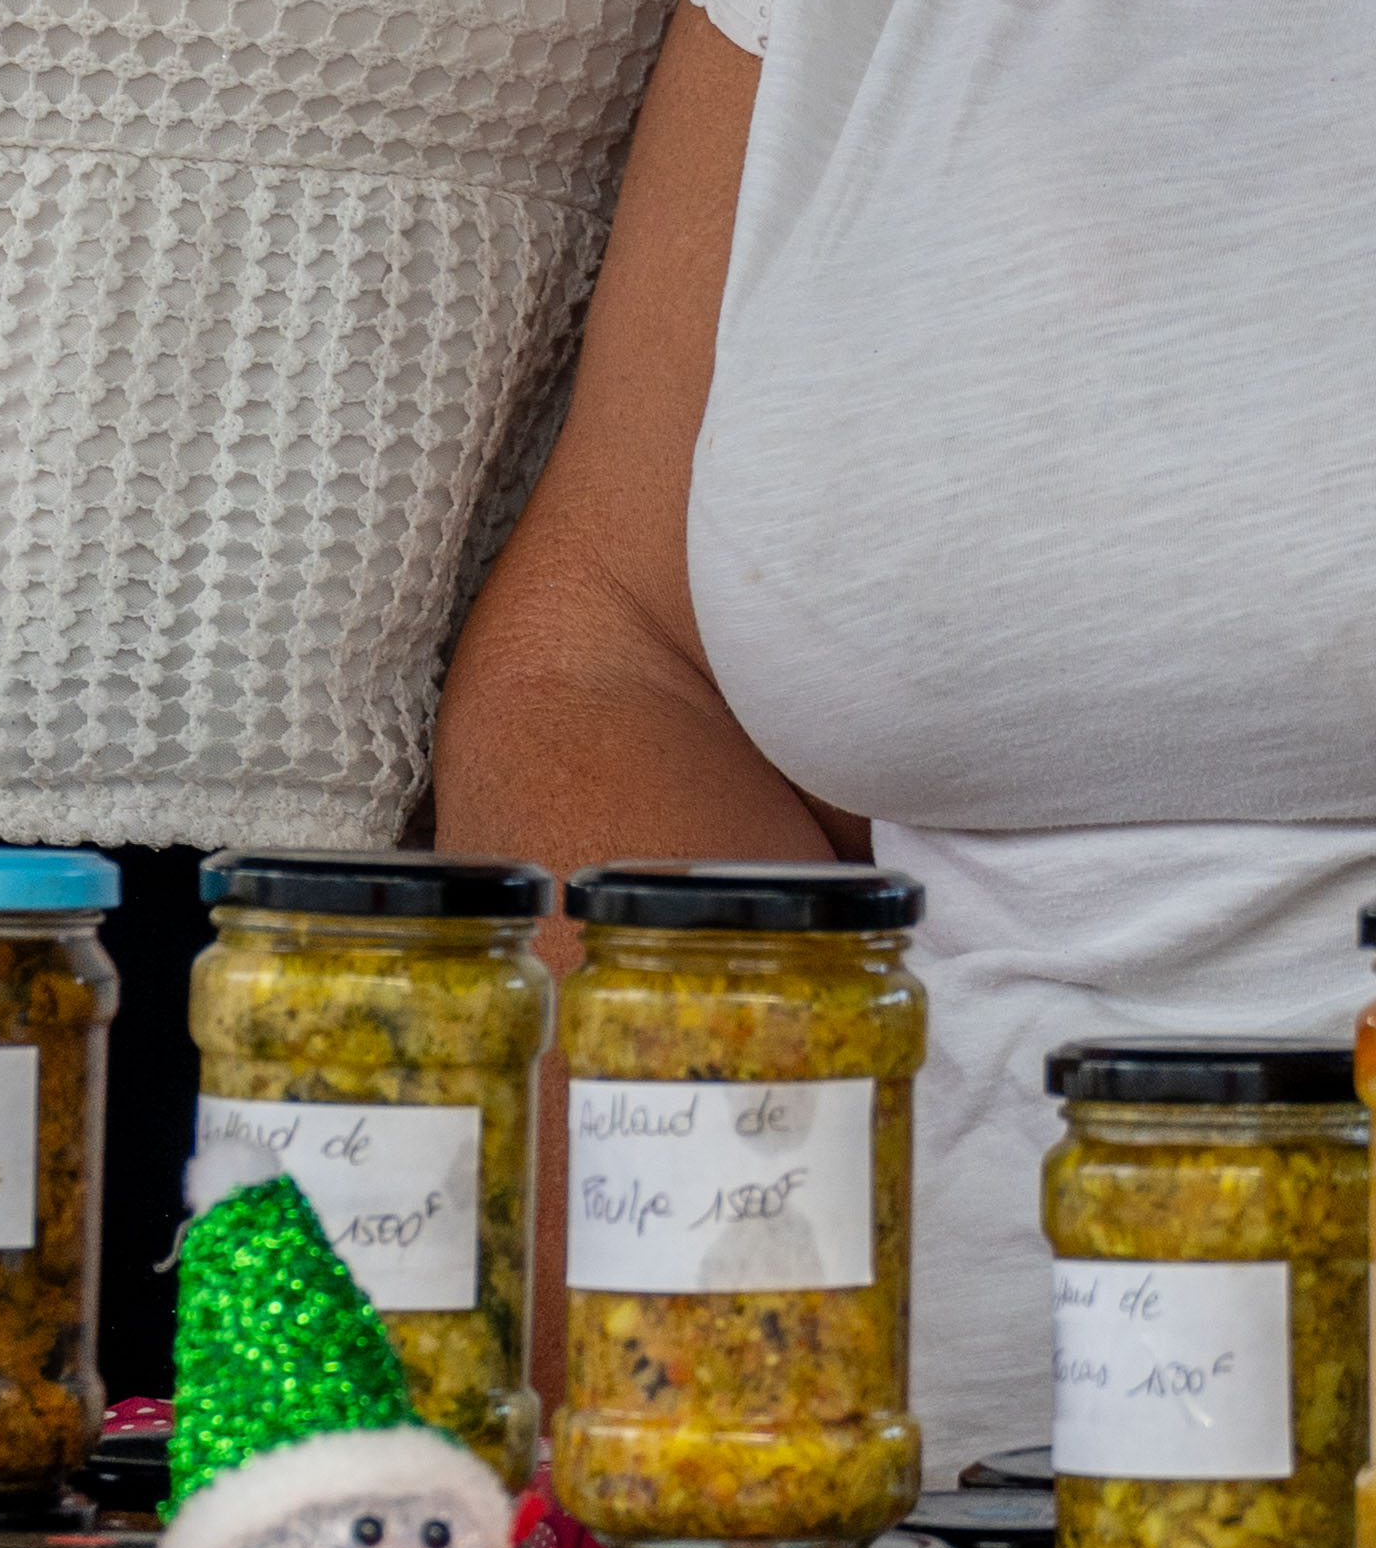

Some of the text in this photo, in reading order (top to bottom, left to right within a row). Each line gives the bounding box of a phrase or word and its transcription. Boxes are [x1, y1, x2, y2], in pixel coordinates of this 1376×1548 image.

[735, 1089, 793, 1138] de
[321, 1117, 371, 1166] de
[1119, 1272, 1162, 1321] de
